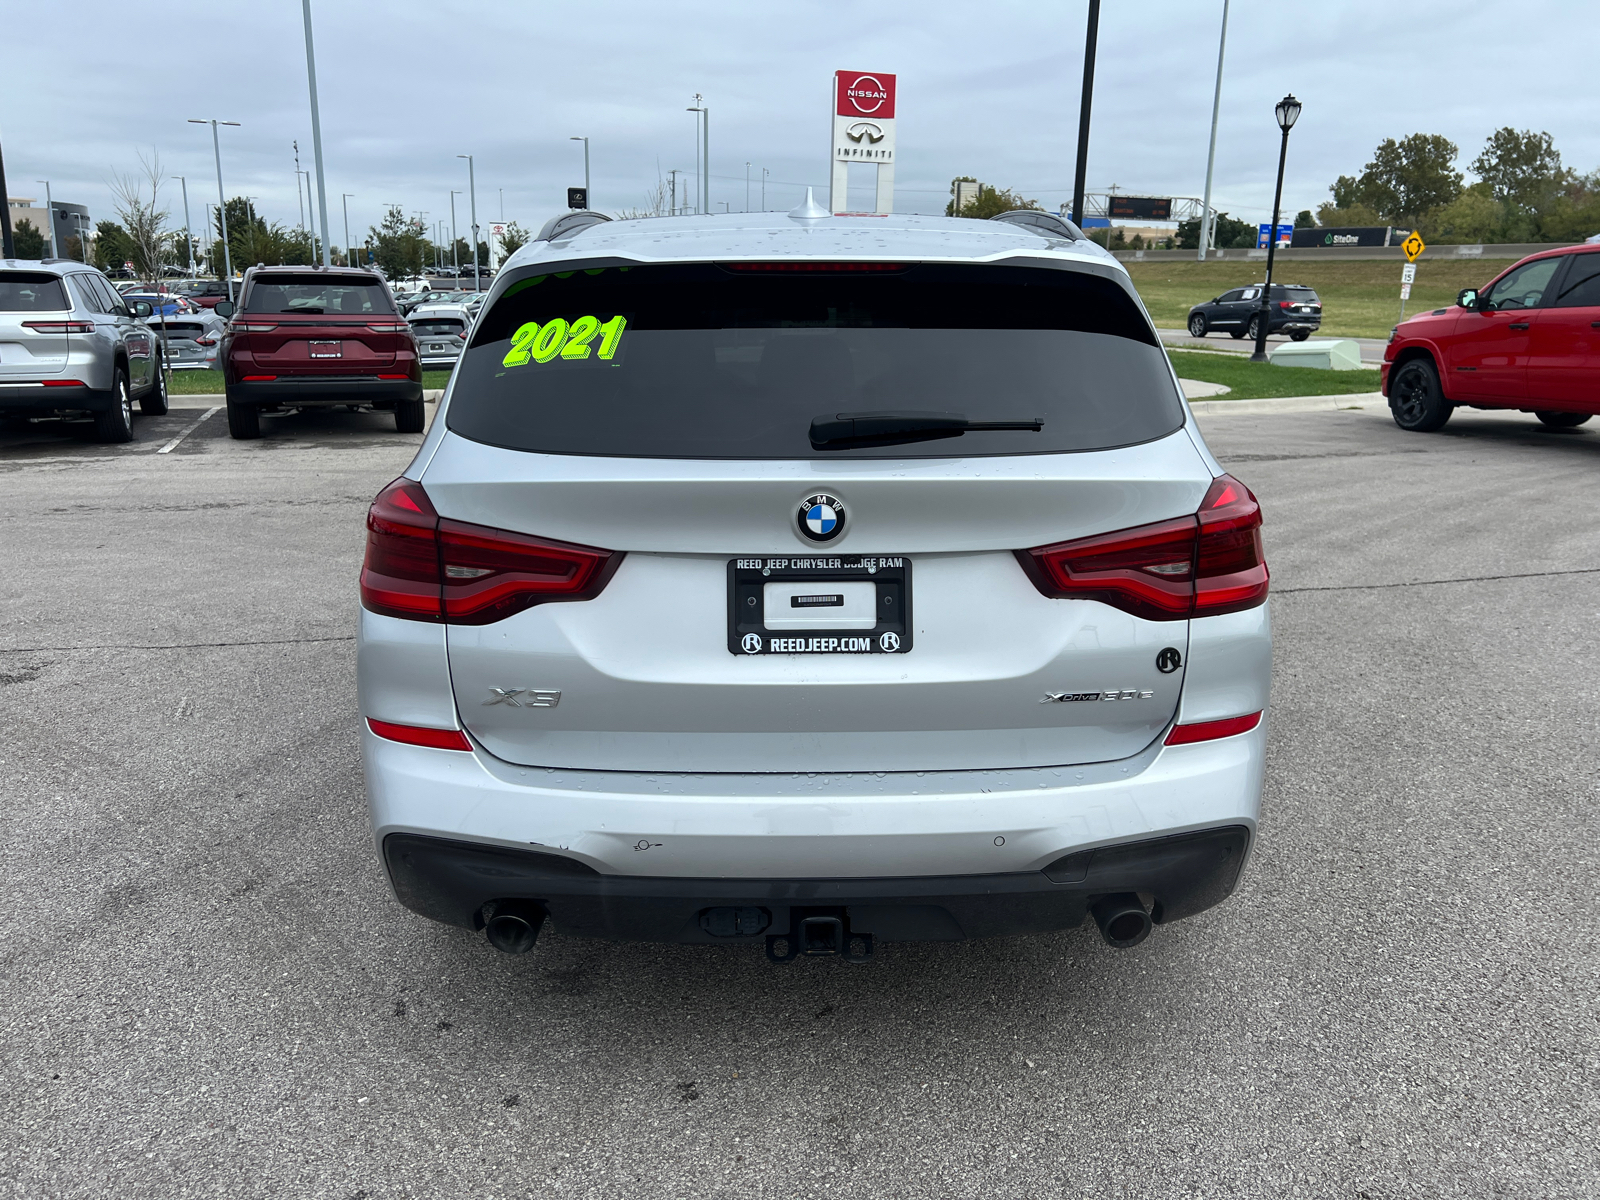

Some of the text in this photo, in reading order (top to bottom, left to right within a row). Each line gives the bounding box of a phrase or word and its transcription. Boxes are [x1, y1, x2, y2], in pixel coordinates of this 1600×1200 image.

[847, 89, 887, 99] NISSAN
[837, 147, 892, 159] INFINITI
[1333, 234, 1359, 243] SiteOne
[1403, 273, 1412, 281] 15
[502, 315, 627, 368] 2021
[801, 495, 842, 512] BMW
[737, 559, 761, 569] REED
[764, 559, 788, 569] JEEP
[791, 559, 841, 569] CHRYSLER
[879, 558, 903, 568] RAM
[771, 638, 870, 651] REEDJEEP.COM
[479, 686, 561, 707] X3
